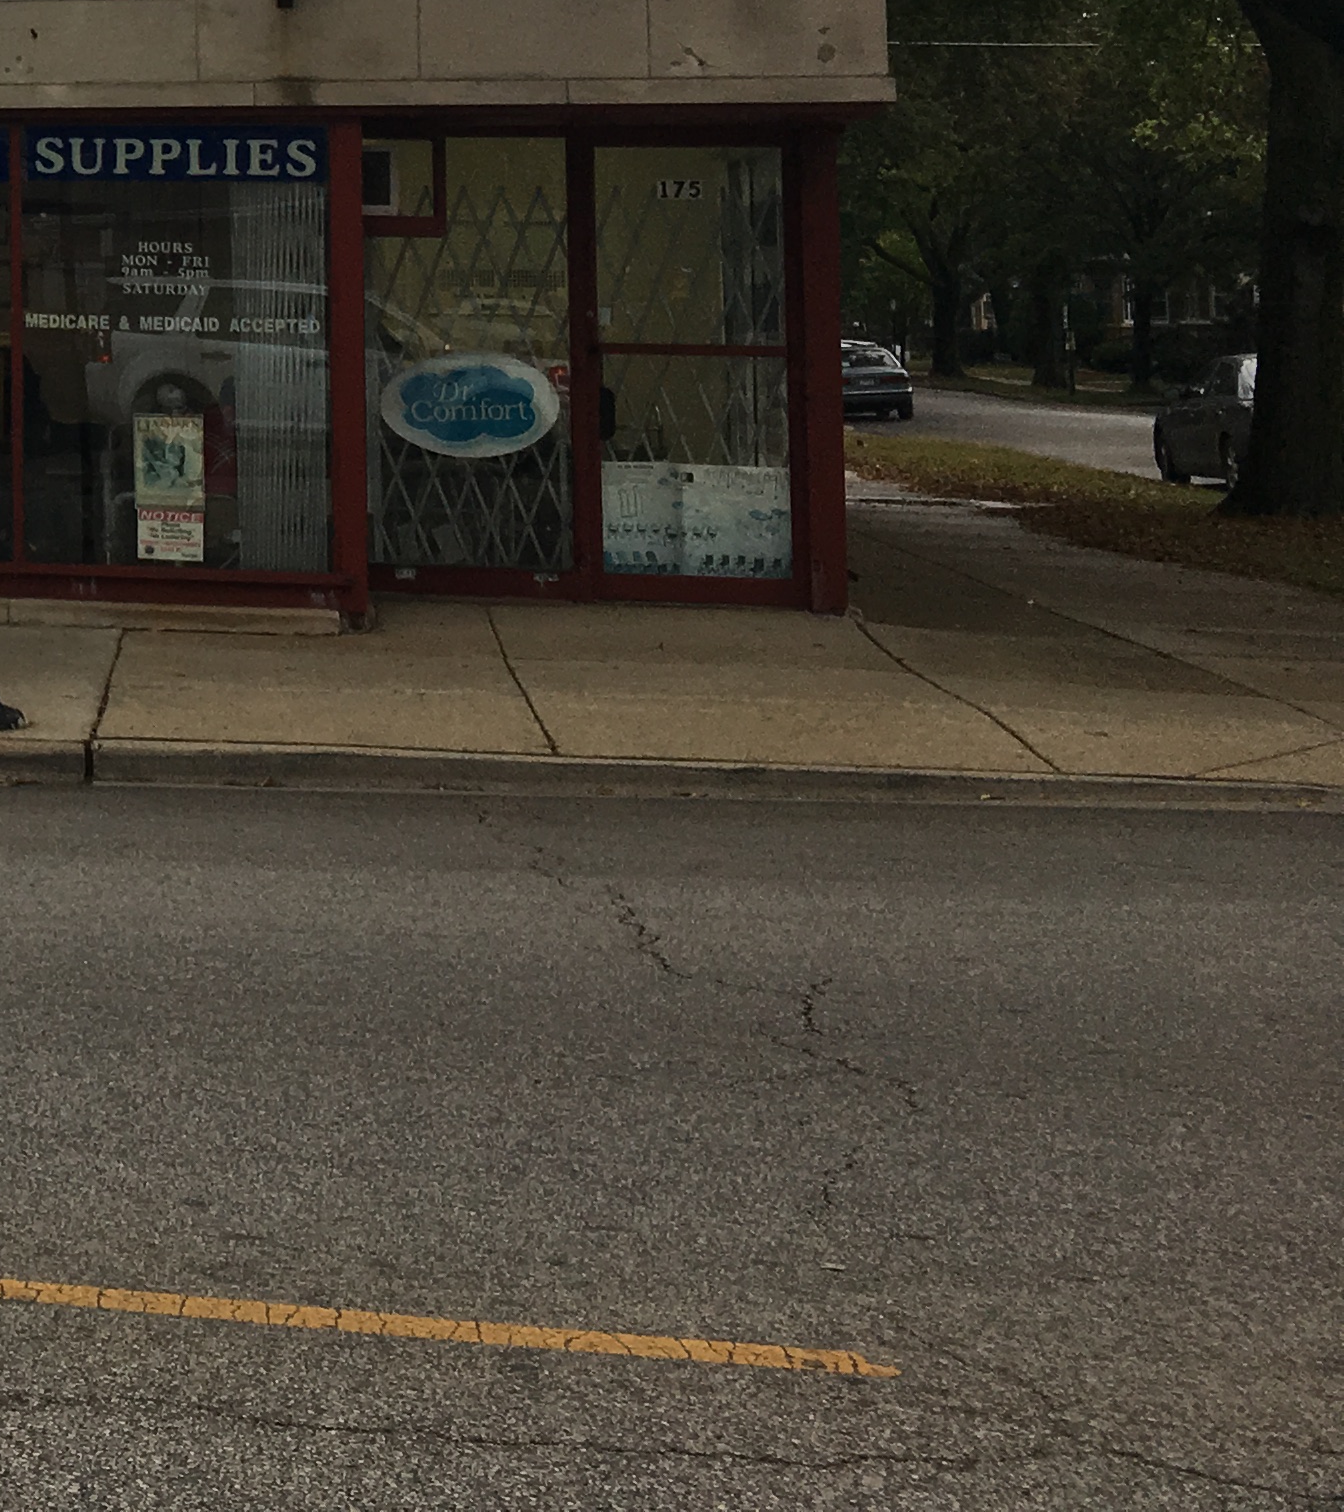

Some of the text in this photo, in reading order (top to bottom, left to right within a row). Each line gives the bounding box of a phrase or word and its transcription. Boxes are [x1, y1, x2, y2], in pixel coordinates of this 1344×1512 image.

[34, 137, 318, 178] SUPPLIES
[138, 241, 193, 253] HOURS
[121, 255, 158, 266] MON
[182, 255, 210, 268] FRI
[121, 267, 153, 277] 9am
[178, 268, 209, 279] 5pm
[122, 284, 208, 296] SATURDAY
[25, 313, 321, 333] MEDICARE & MEDICAID ACCEPTED
[412, 398, 528, 422] Comfort
